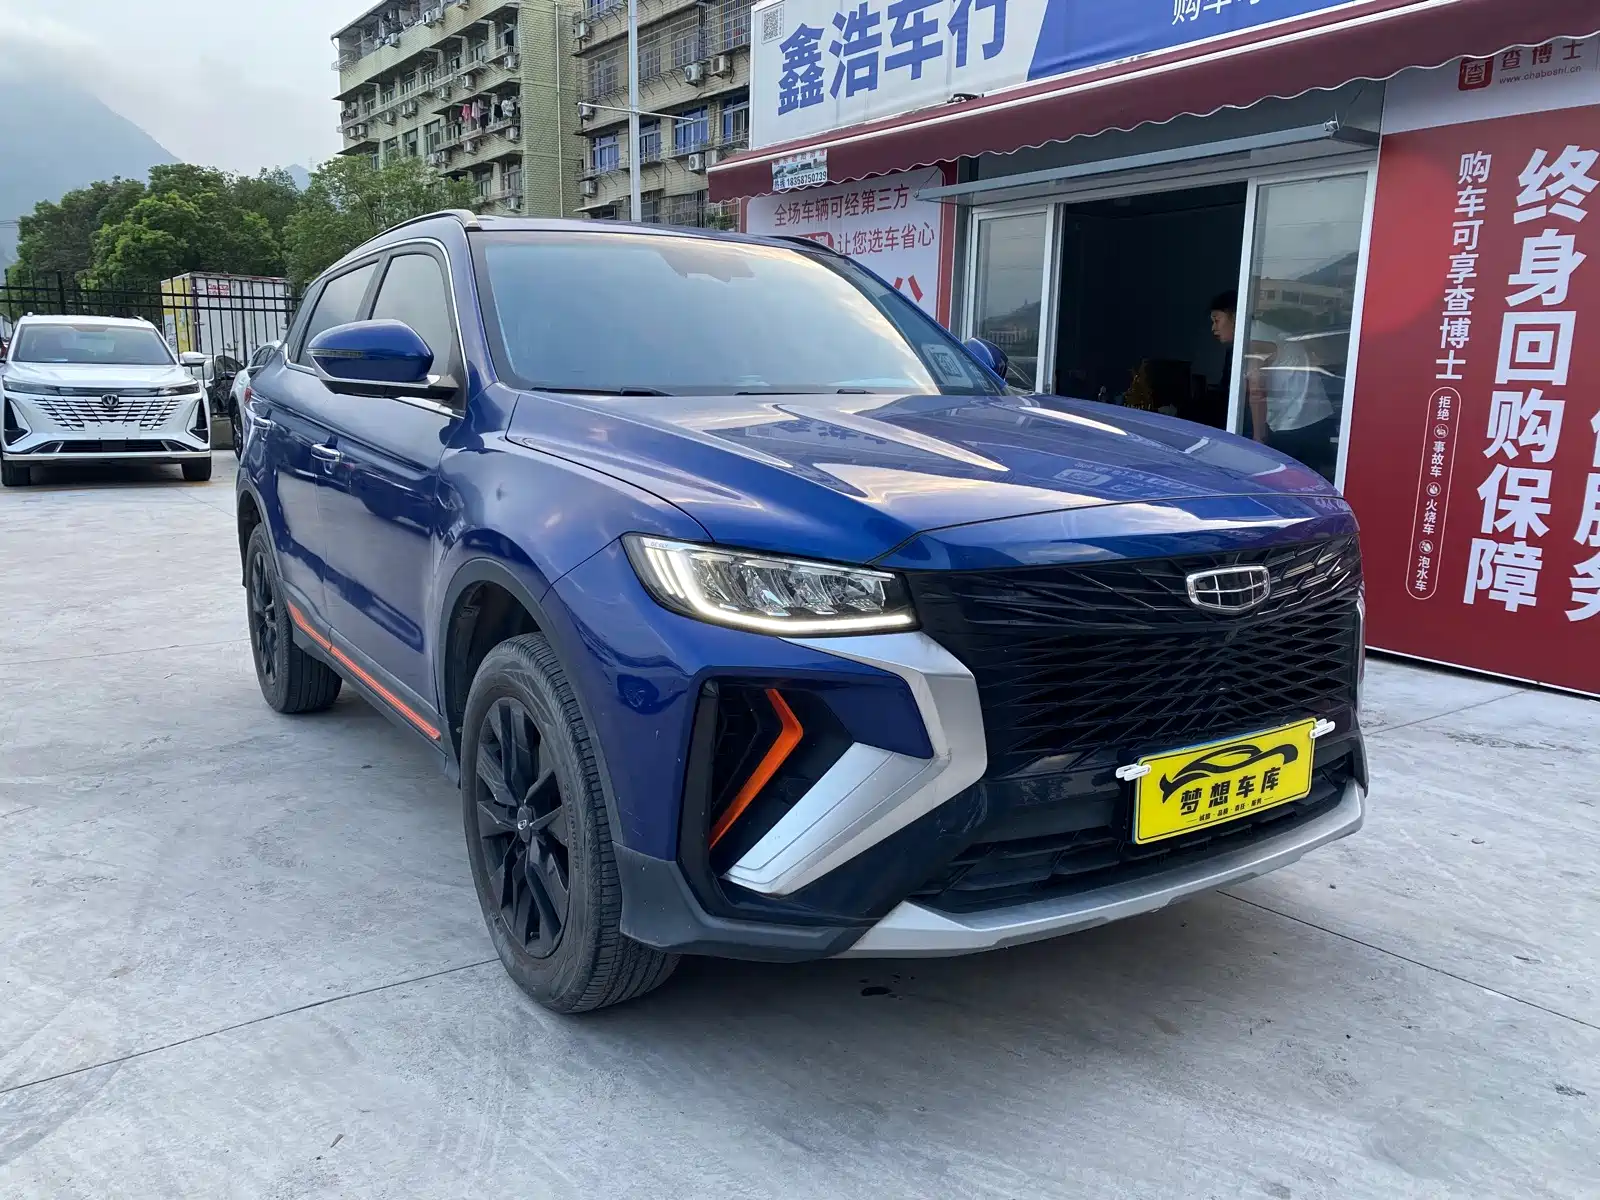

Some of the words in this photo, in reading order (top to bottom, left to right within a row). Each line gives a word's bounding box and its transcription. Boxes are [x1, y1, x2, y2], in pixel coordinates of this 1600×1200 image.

[778, 0, 1007, 116] 鑫浩车行
[1500, 40, 1584, 71] 查博士
[1499, 65, 1582, 84] www.chaboshi.cn
[774, 184, 910, 227] 全场车辆可经第三方
[838, 222, 935, 256] 让您选车省心
[1435, 150, 1492, 380] 购车可享查博士
[1463, 145, 1600, 612] 终身回购保障
[1436, 396, 1452, 421] 拒绝
[1430, 441, 1446, 478] 事故车
[1422, 500, 1438, 535] 火烧车
[1414, 556, 1431, 592] 泡水车
[1181, 767, 1281, 816] 梦想车库
